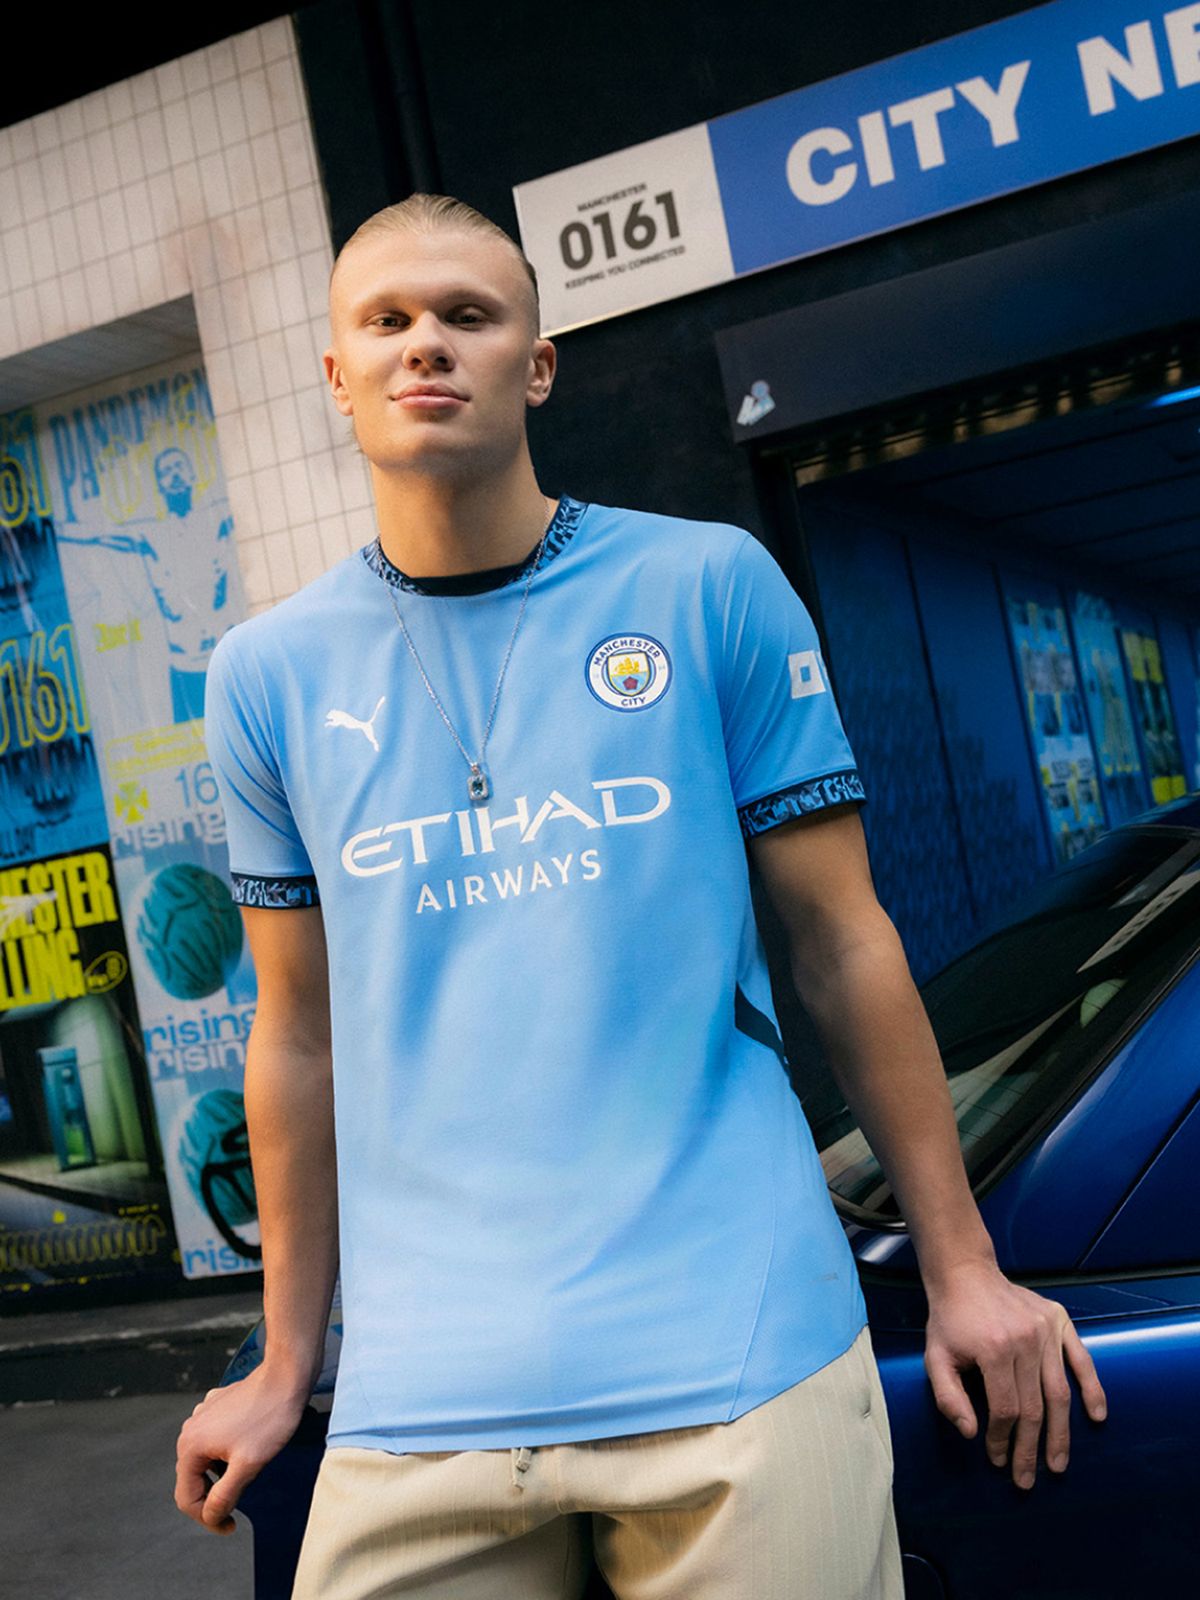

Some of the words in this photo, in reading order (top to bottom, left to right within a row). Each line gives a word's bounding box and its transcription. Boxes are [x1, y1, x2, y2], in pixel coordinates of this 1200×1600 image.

[786, 60, 1031, 206] CITY
[560, 190, 680, 270] 0161
[578, 183, 647, 212] MANCHESTER
[564, 271, 606, 290] KEEPING
[606, 264, 628, 277] YOU
[629, 246, 686, 271] CONNECTED
[593, 638, 661, 667] MANCHESTER
[0, 623, 92, 750] 161
[620, 696, 646, 707] CITY
[341, 776, 672, 878] ETIHAD
[415, 848, 601, 914] AIRWAYS
